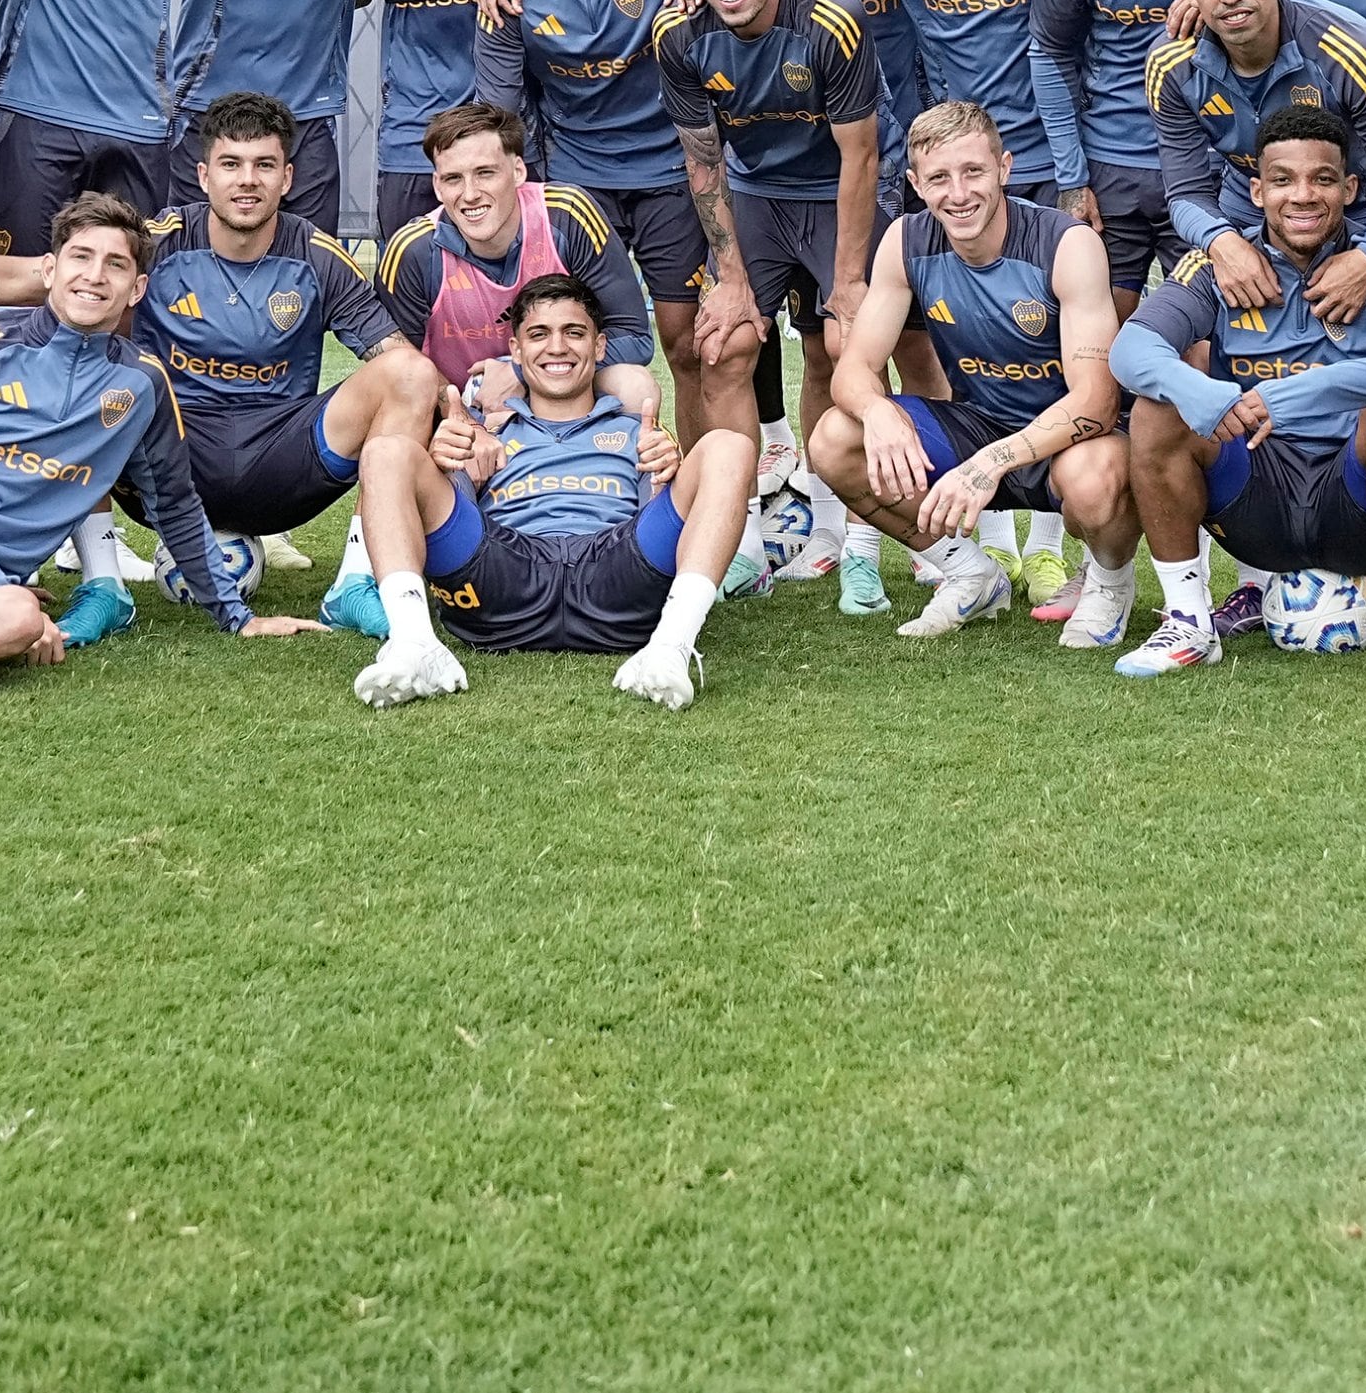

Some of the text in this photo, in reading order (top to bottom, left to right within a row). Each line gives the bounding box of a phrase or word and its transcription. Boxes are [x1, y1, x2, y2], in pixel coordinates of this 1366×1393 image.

[273, 304, 297, 314] CABJ
[1019, 313, 1043, 324] CABJ
[170, 343, 289, 383] betsson
[958, 356, 1063, 382] etsson
[105, 401, 127, 412] CABJ
